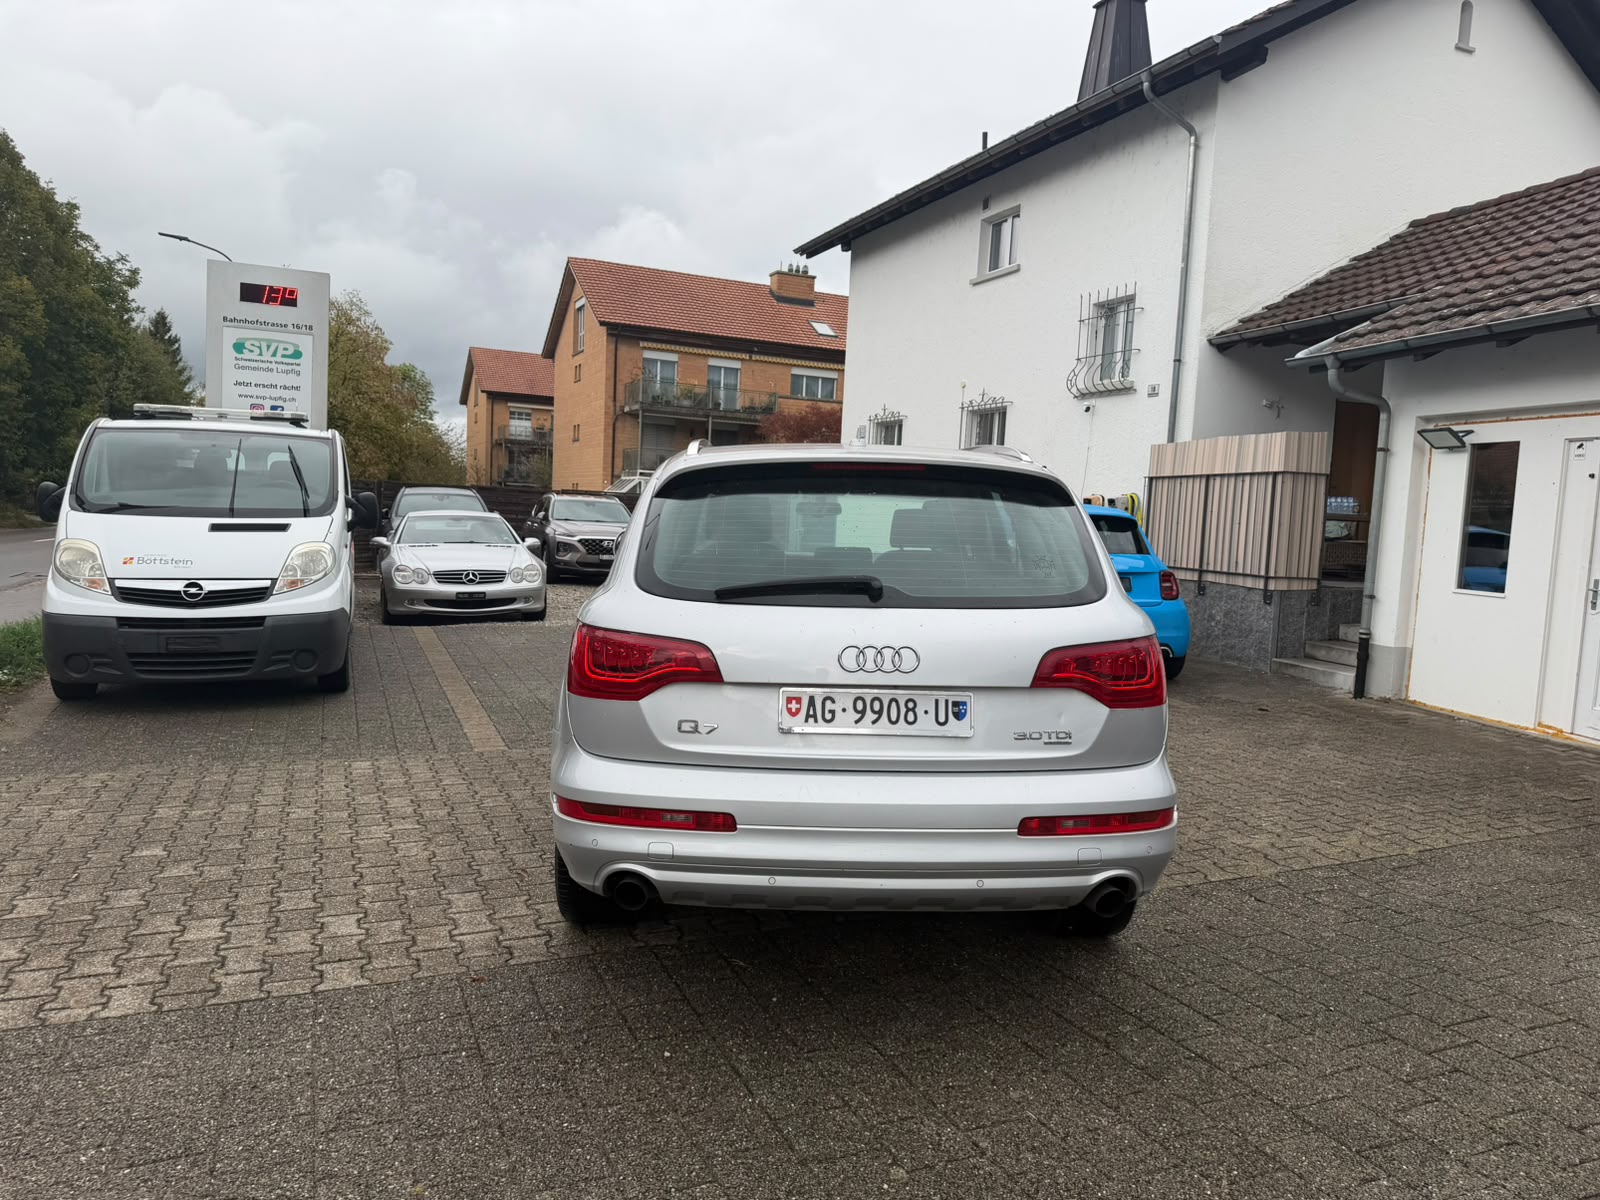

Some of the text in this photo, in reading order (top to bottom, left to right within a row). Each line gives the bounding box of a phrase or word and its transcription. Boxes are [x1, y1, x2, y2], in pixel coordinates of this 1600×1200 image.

[222, 316, 313, 331] Bahnhofstrasse 16/18
[243, 340, 294, 357] SVP
[234, 363, 301, 377] Gemeinde Lupfig
[233, 380, 252, 388] Jetzt
[254, 382, 278, 390] erscht
[238, 393, 296, 402] www.svp-lupfig.ch
[677, 719, 719, 735] Q7
